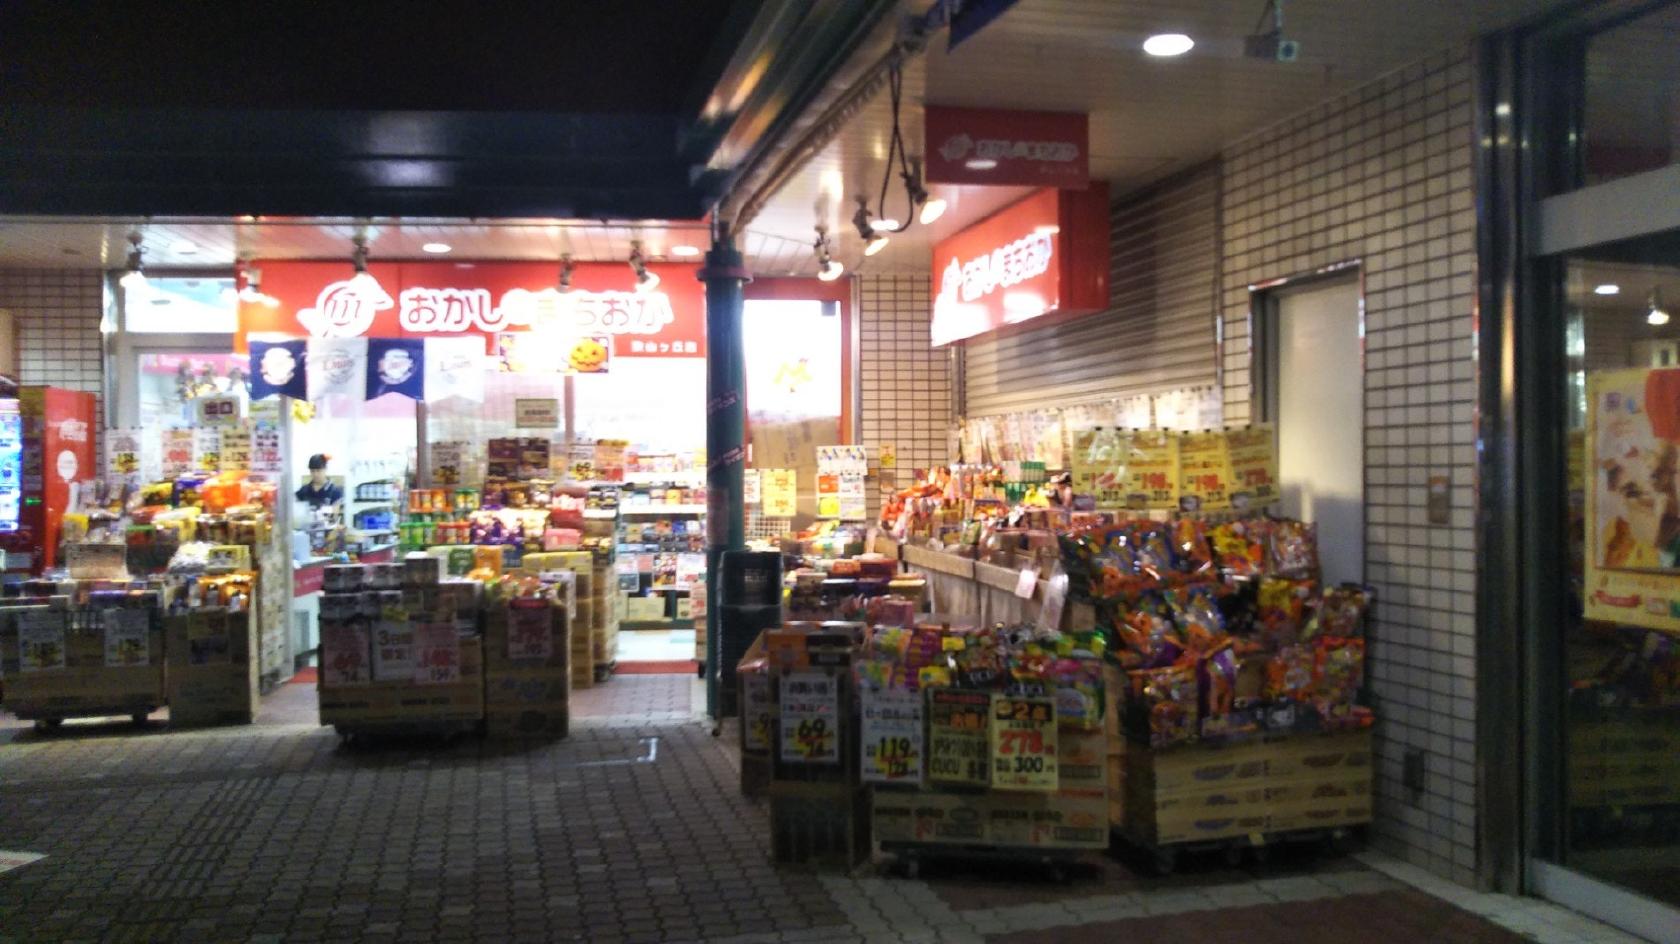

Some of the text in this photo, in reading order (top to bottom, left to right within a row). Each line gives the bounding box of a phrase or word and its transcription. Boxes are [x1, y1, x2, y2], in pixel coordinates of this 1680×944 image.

[798, 718, 826, 738] 69
[880, 736, 911, 758] 119
[999, 729, 1044, 753] 278
[1014, 756, 1044, 773] 300
